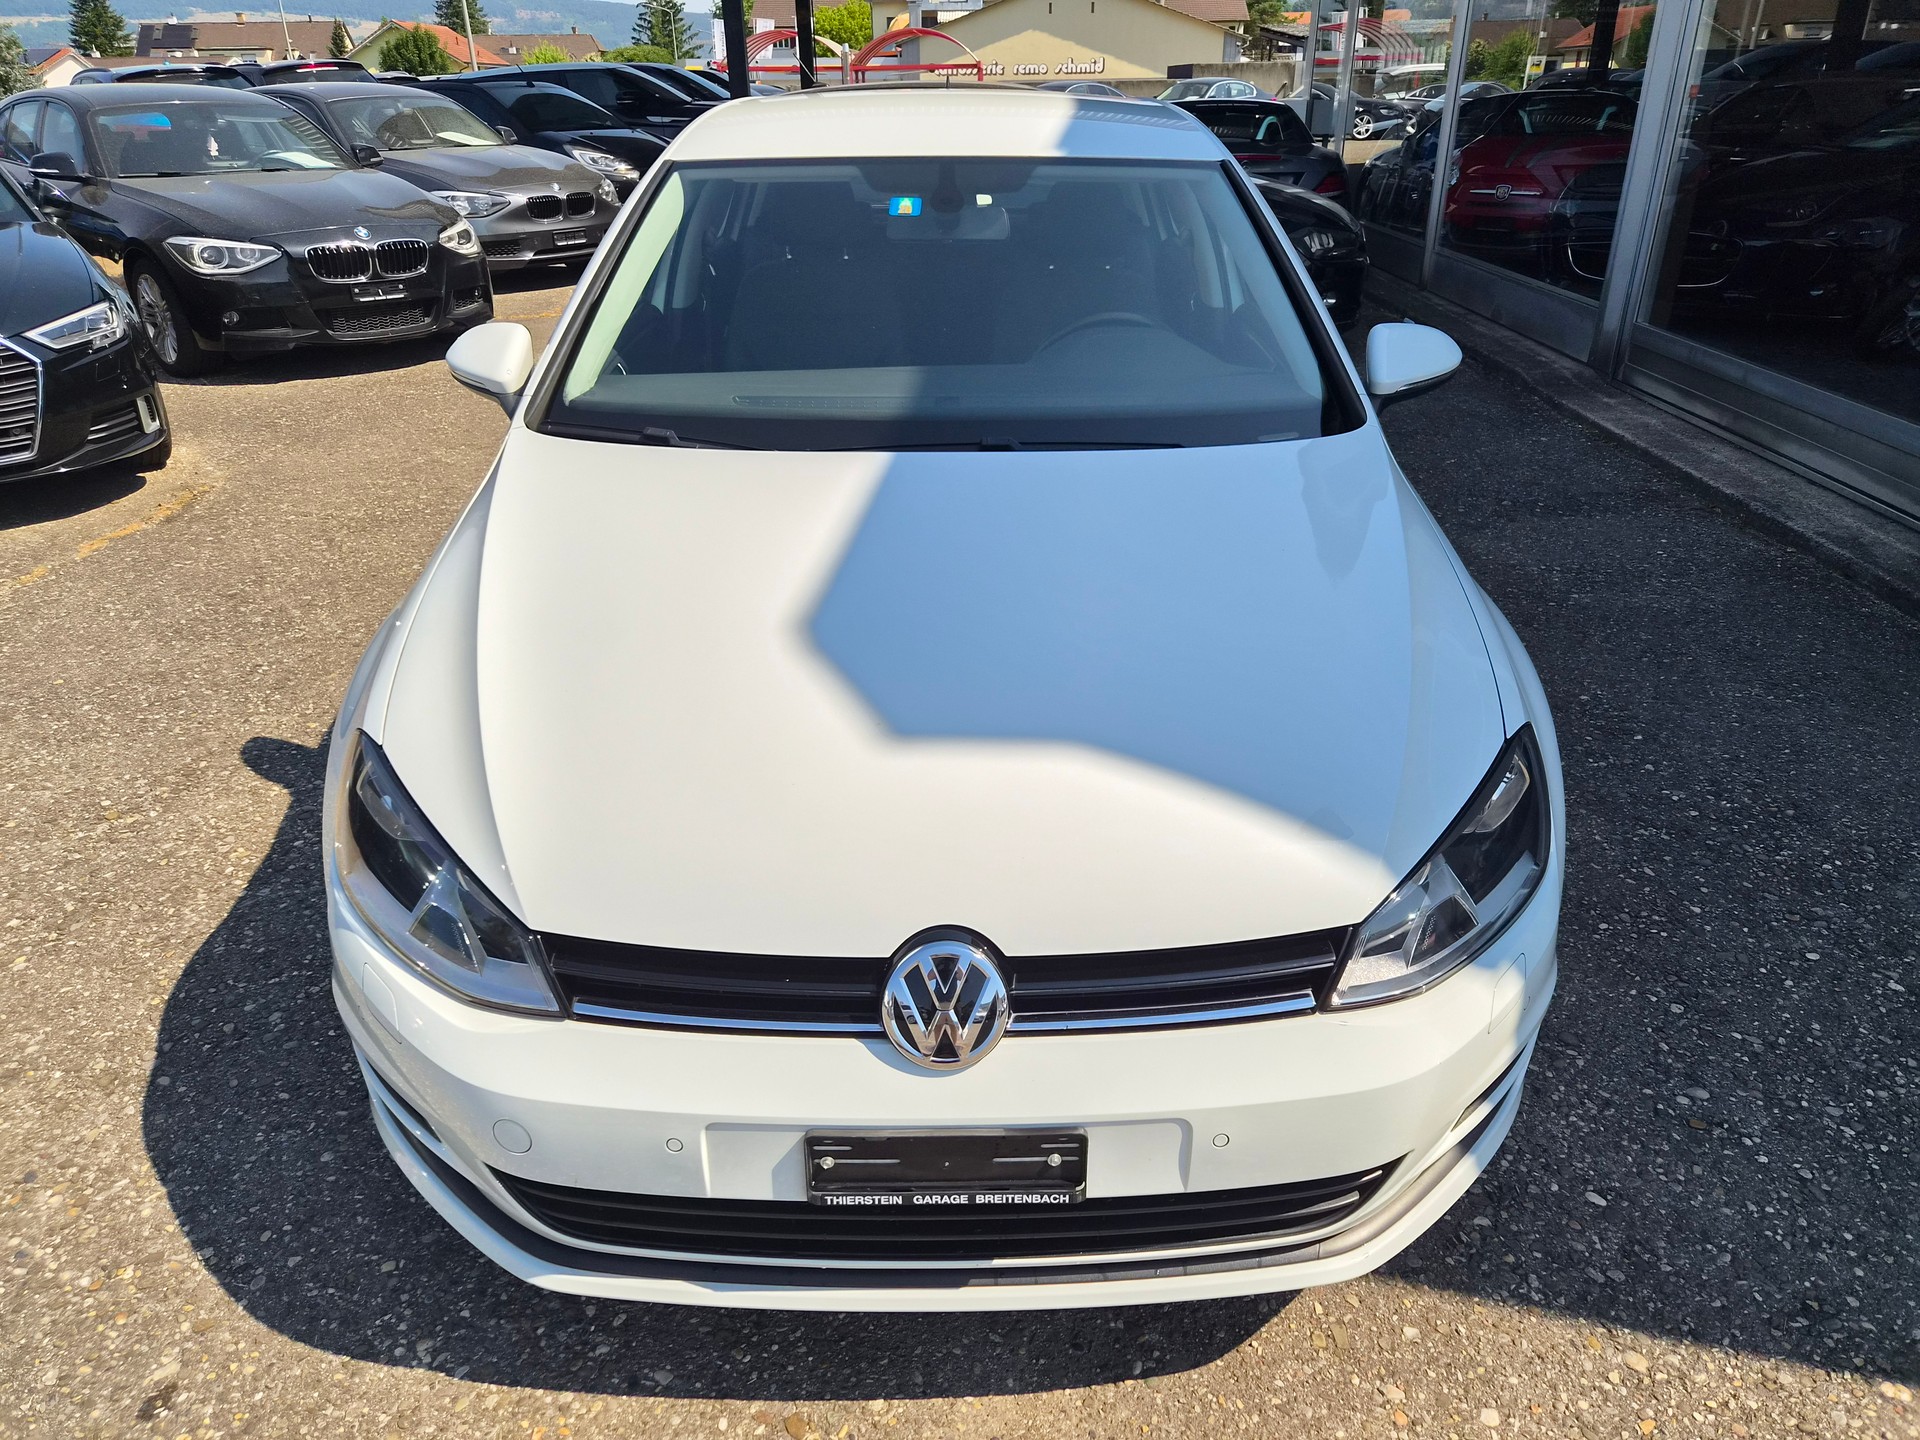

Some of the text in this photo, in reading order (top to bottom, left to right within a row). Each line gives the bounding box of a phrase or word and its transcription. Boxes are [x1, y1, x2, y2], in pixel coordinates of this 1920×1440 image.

[1013, 64, 1048, 75] remo
[1054, 57, 1105, 75] schmid
[888, 946, 1004, 1066] VW
[824, 1194, 1069, 1205] THIERSTEIN GARAGE BREITENBACH
